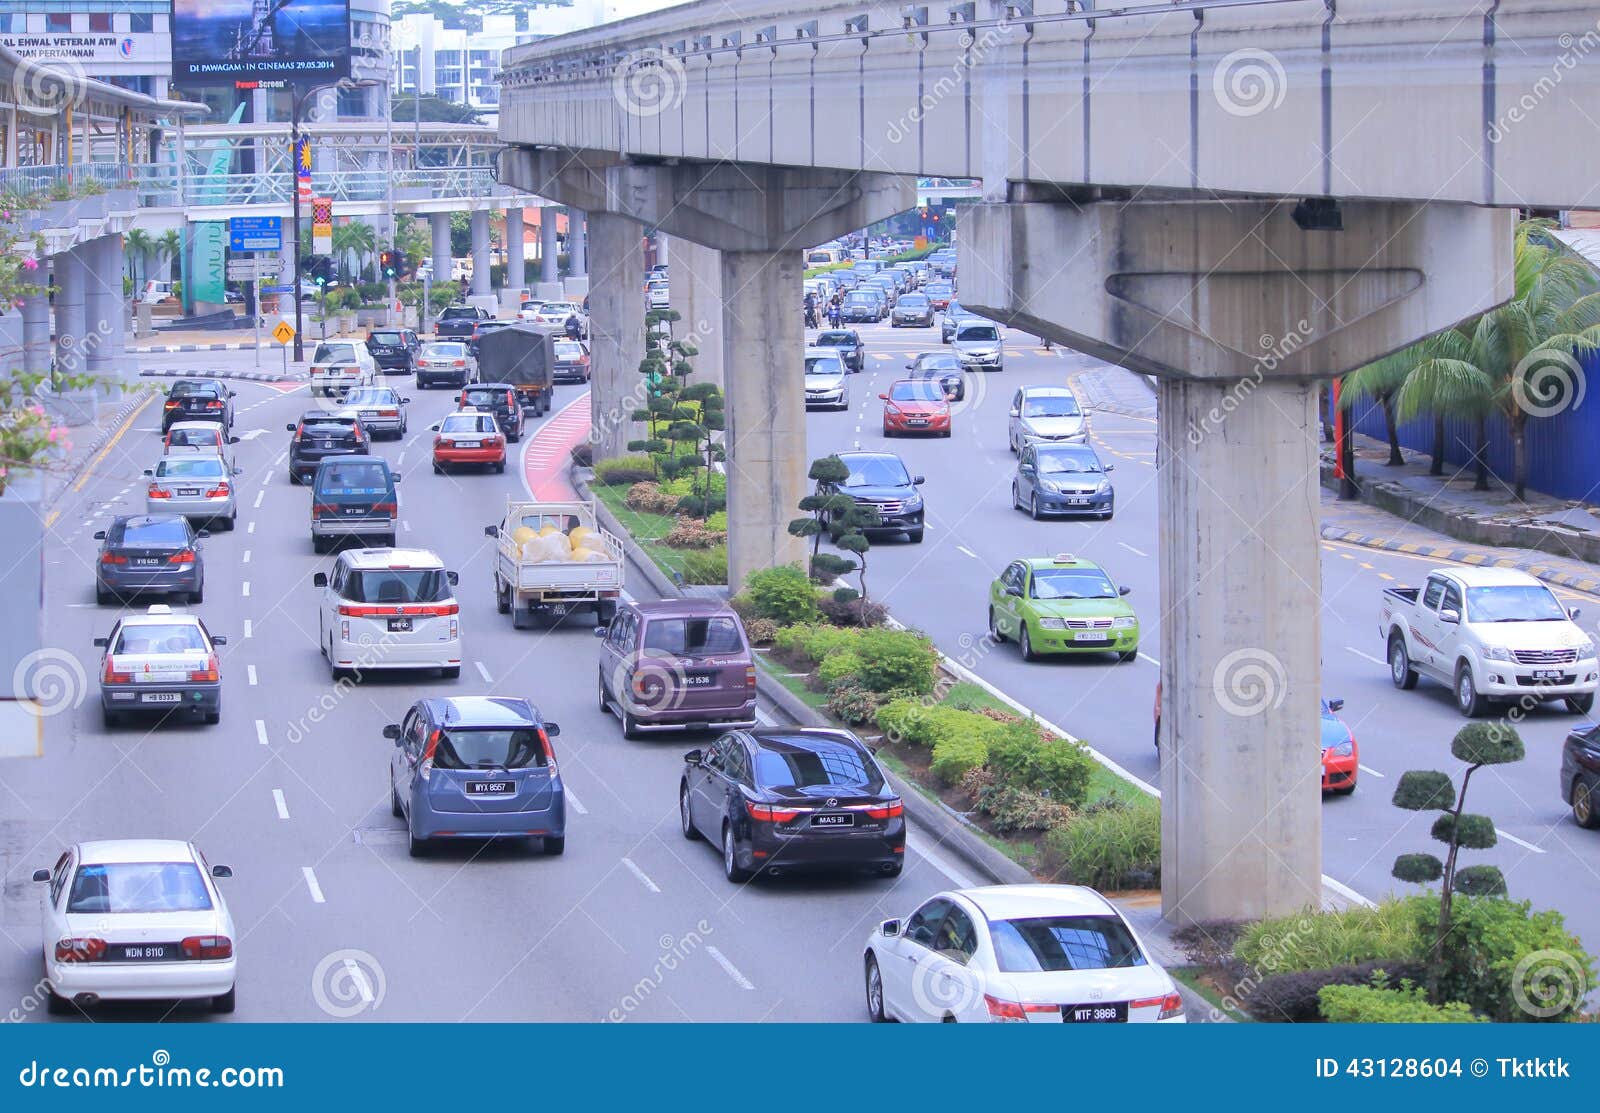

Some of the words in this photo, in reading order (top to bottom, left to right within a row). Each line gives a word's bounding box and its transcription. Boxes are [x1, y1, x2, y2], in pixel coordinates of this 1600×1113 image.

[0, 38, 16, 47] AL
[18, 38, 50, 46] EHWAL
[53, 38, 96, 46] VETERAN
[98, 38, 117, 46] ATM
[39, 49, 95, 57] PERTAHANAN
[190, 64, 200, 72] DI
[201, 64, 242, 72] PAWAGAM
[258, 62, 295, 70] CINEMAS
[296, 61, 335, 69] 29.05.2014
[695, 676, 710, 684] 1536
[475, 783, 489, 792] WYX
[489, 783, 506, 792] 8557
[819, 816, 837, 824] MAS
[125, 947, 143, 958] WDN
[145, 947, 164, 958] 8110
[1074, 1009, 1092, 1021] WTF
